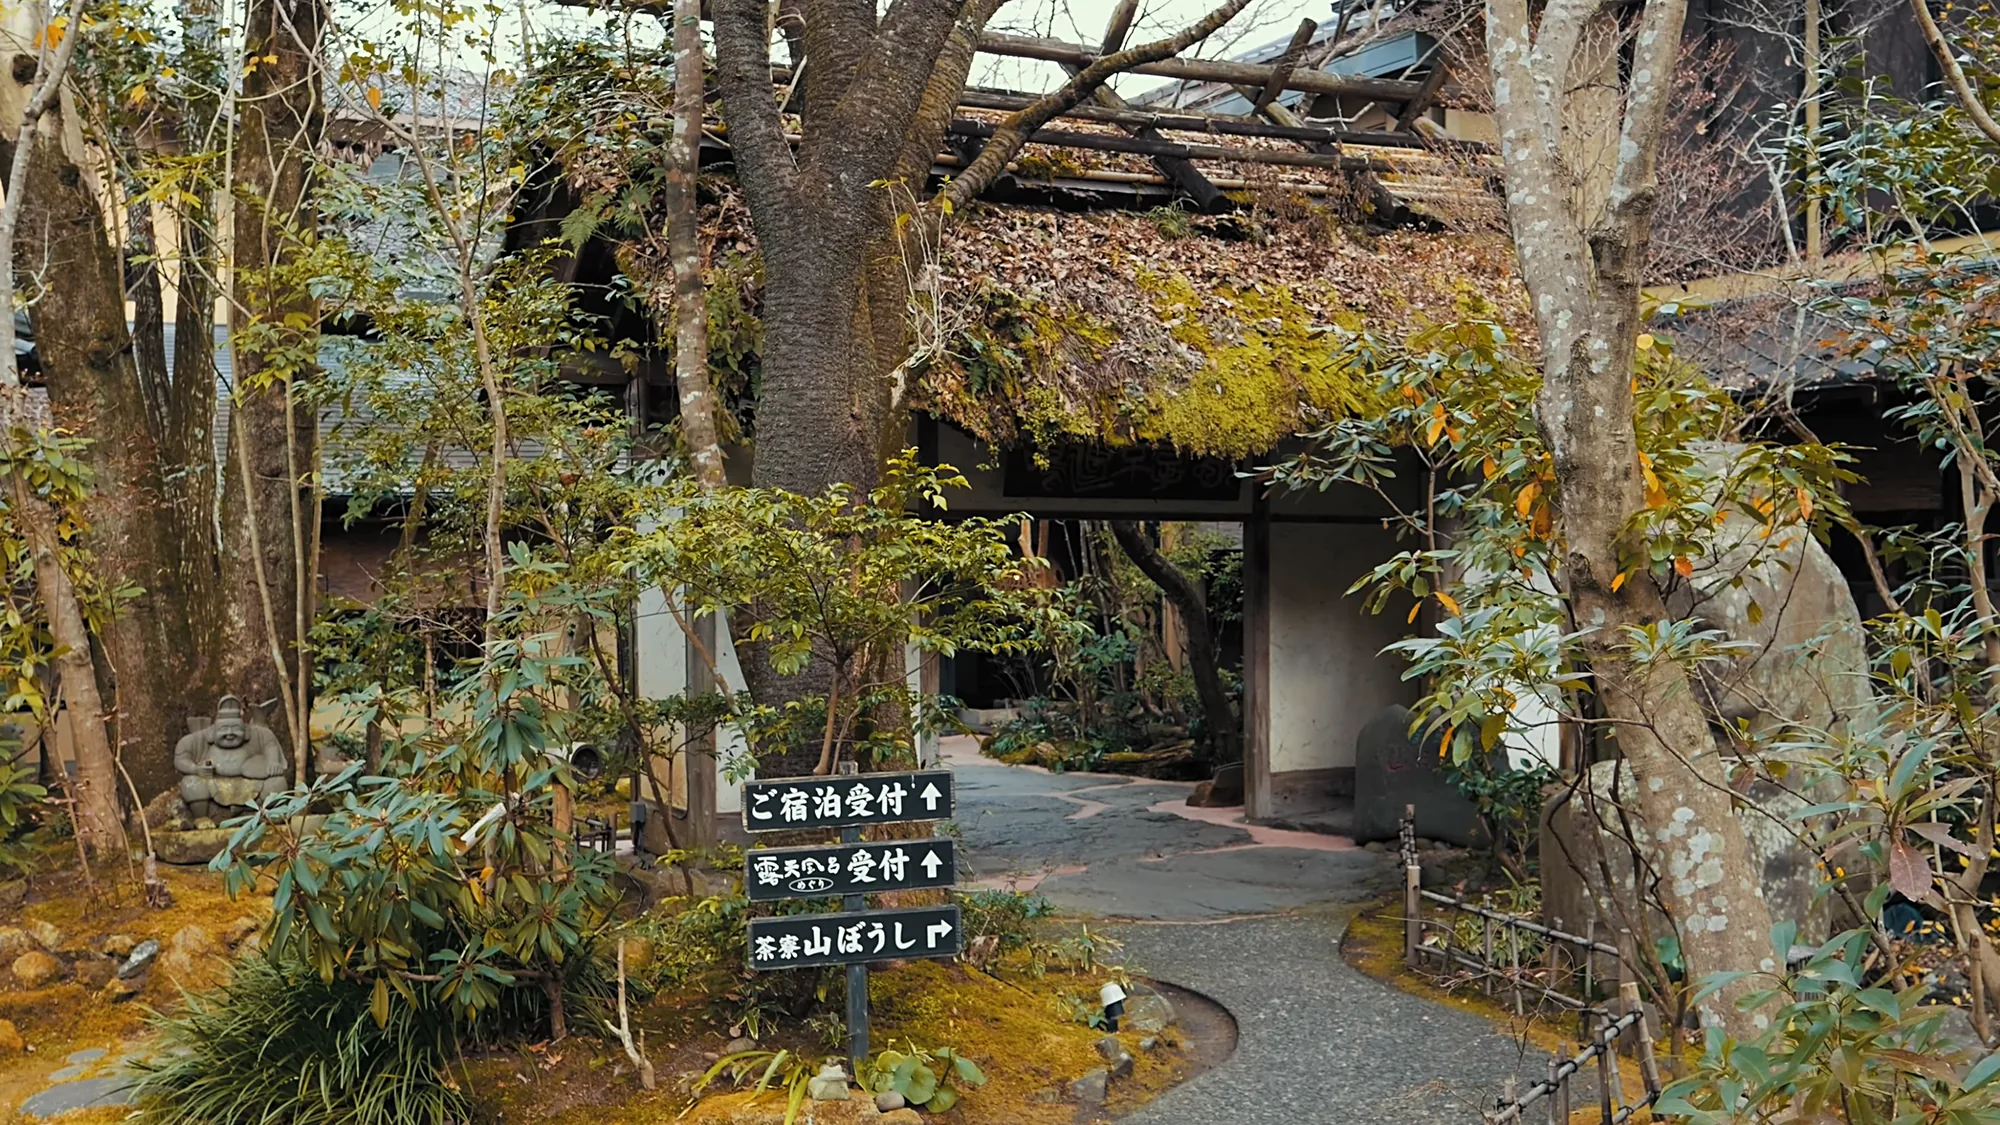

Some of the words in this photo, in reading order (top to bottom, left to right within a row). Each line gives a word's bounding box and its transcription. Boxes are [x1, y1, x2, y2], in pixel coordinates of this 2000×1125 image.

[751, 782, 908, 823] ご宿泊受付
[796, 878, 825, 891] めぐり
